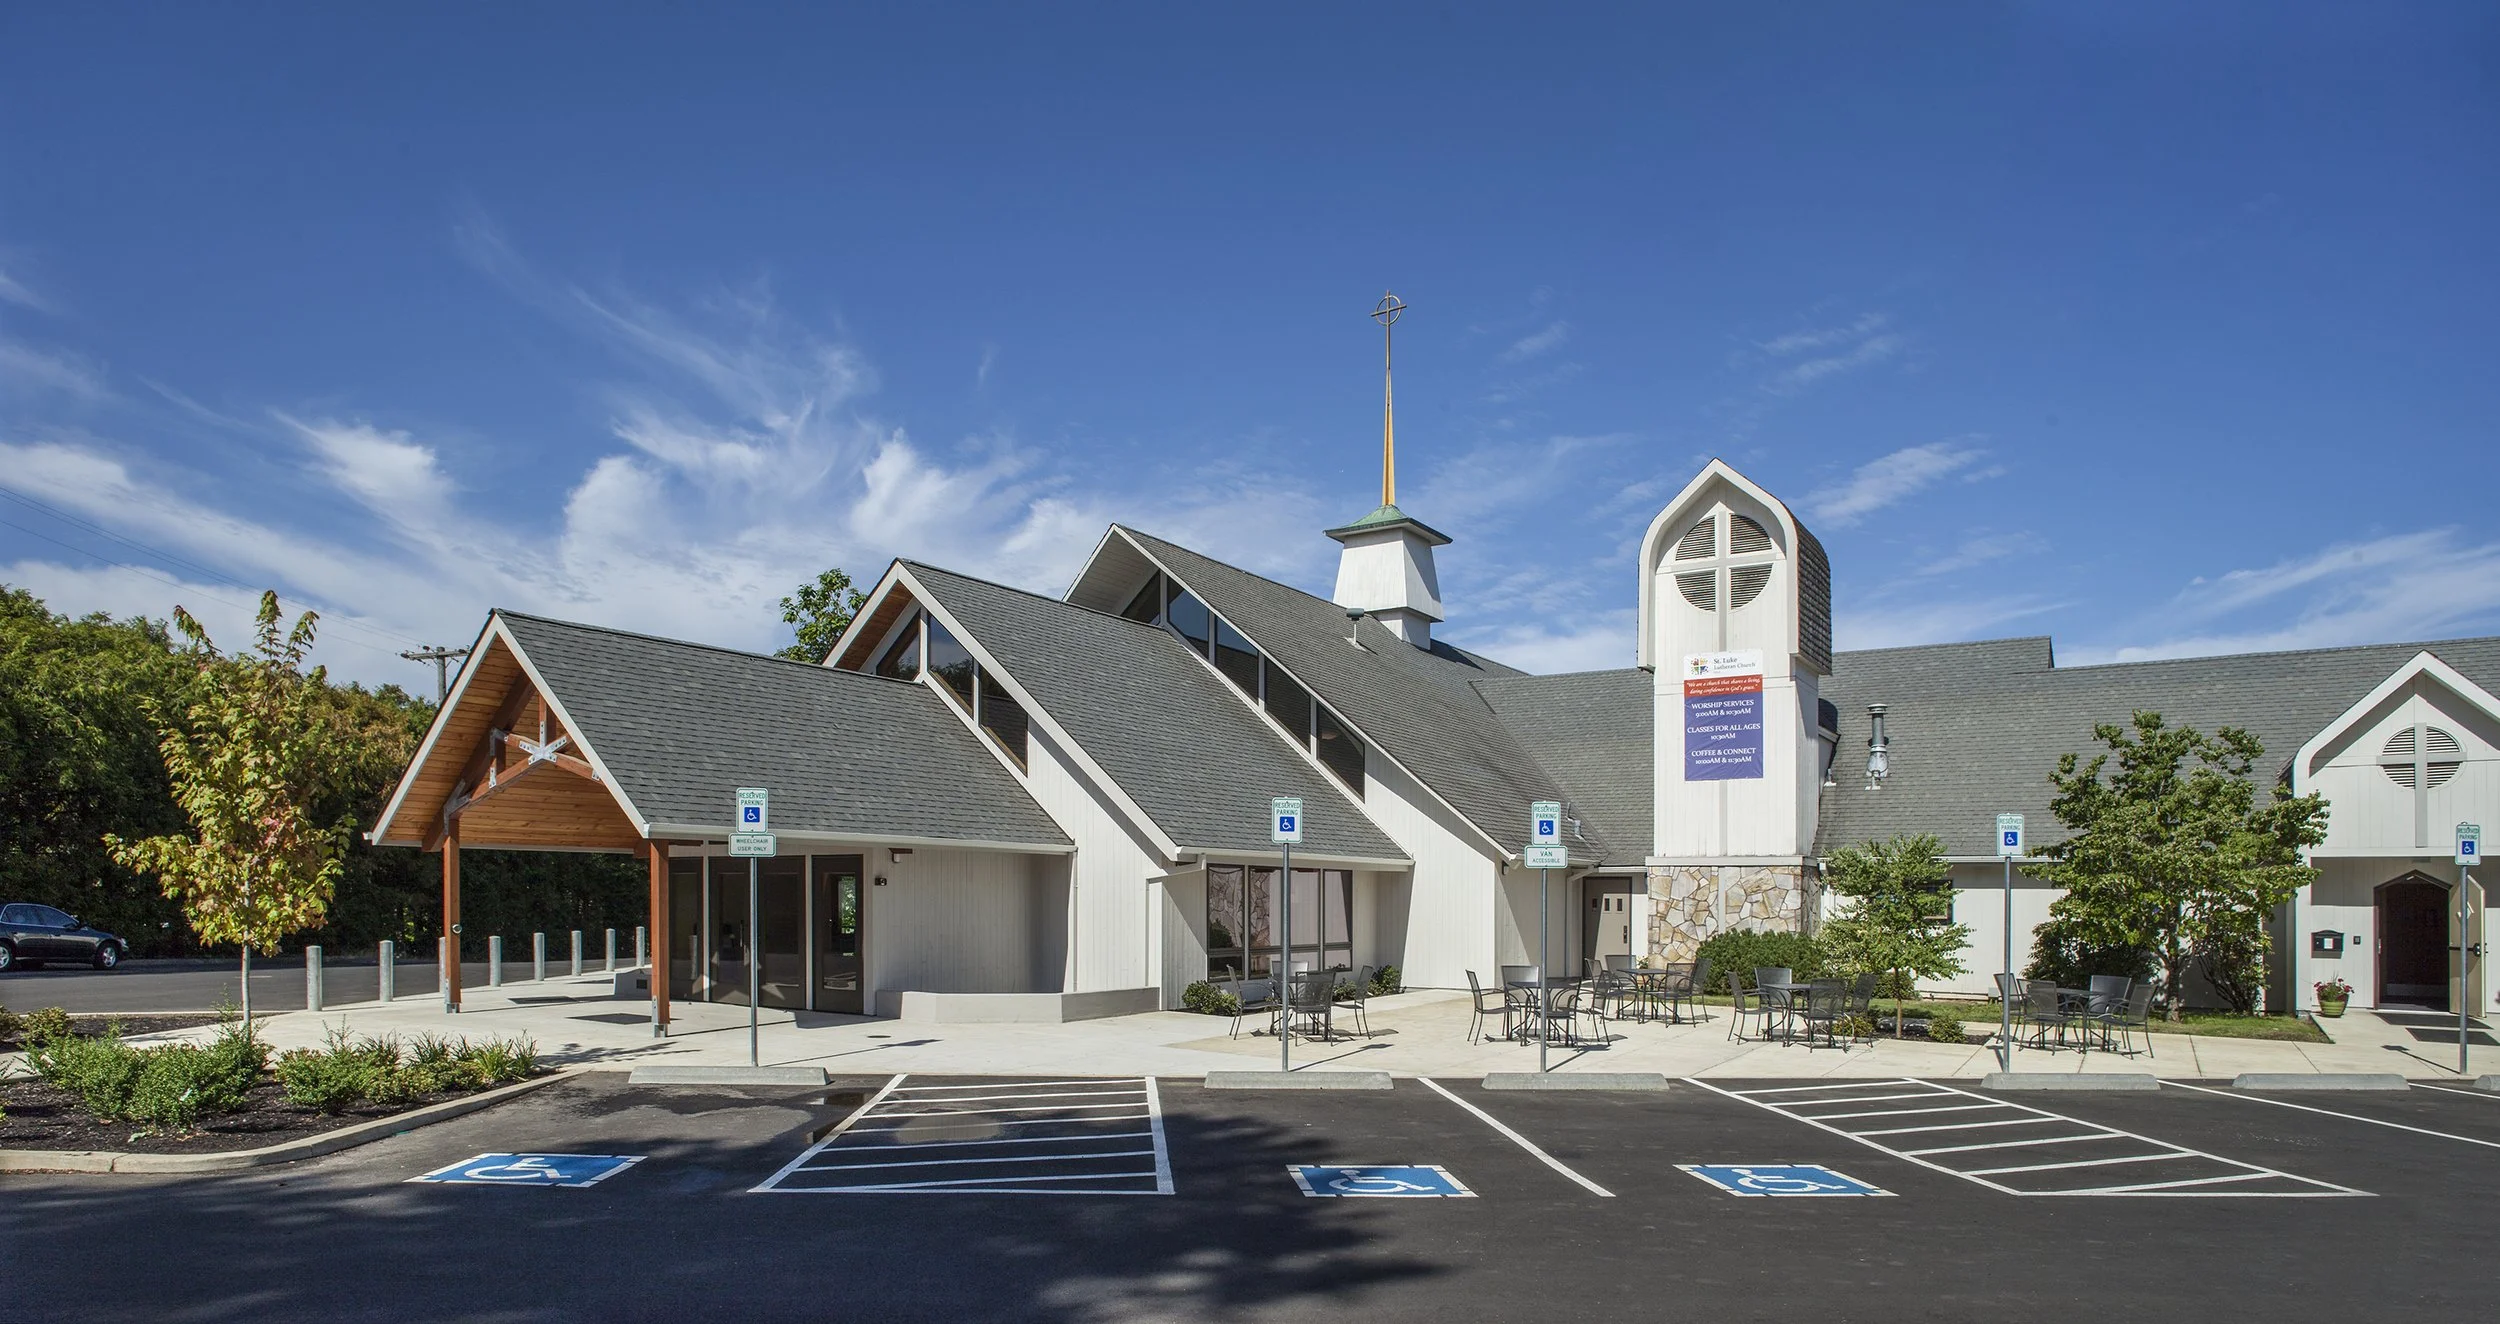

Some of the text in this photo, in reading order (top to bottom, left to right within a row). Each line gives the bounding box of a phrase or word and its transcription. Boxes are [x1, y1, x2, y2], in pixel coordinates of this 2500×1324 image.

[1723, 699, 1754, 707] SERVICES
[1695, 709, 1719, 718] 9:00AM
[1726, 708, 1751, 716] 10:30AM
[1711, 733, 1736, 741] 10:30AM
[1723, 747, 1756, 755] CONNECT
[1695, 757, 1721, 765] 10:00AM
[1728, 756, 1752, 765] 11:30AM
